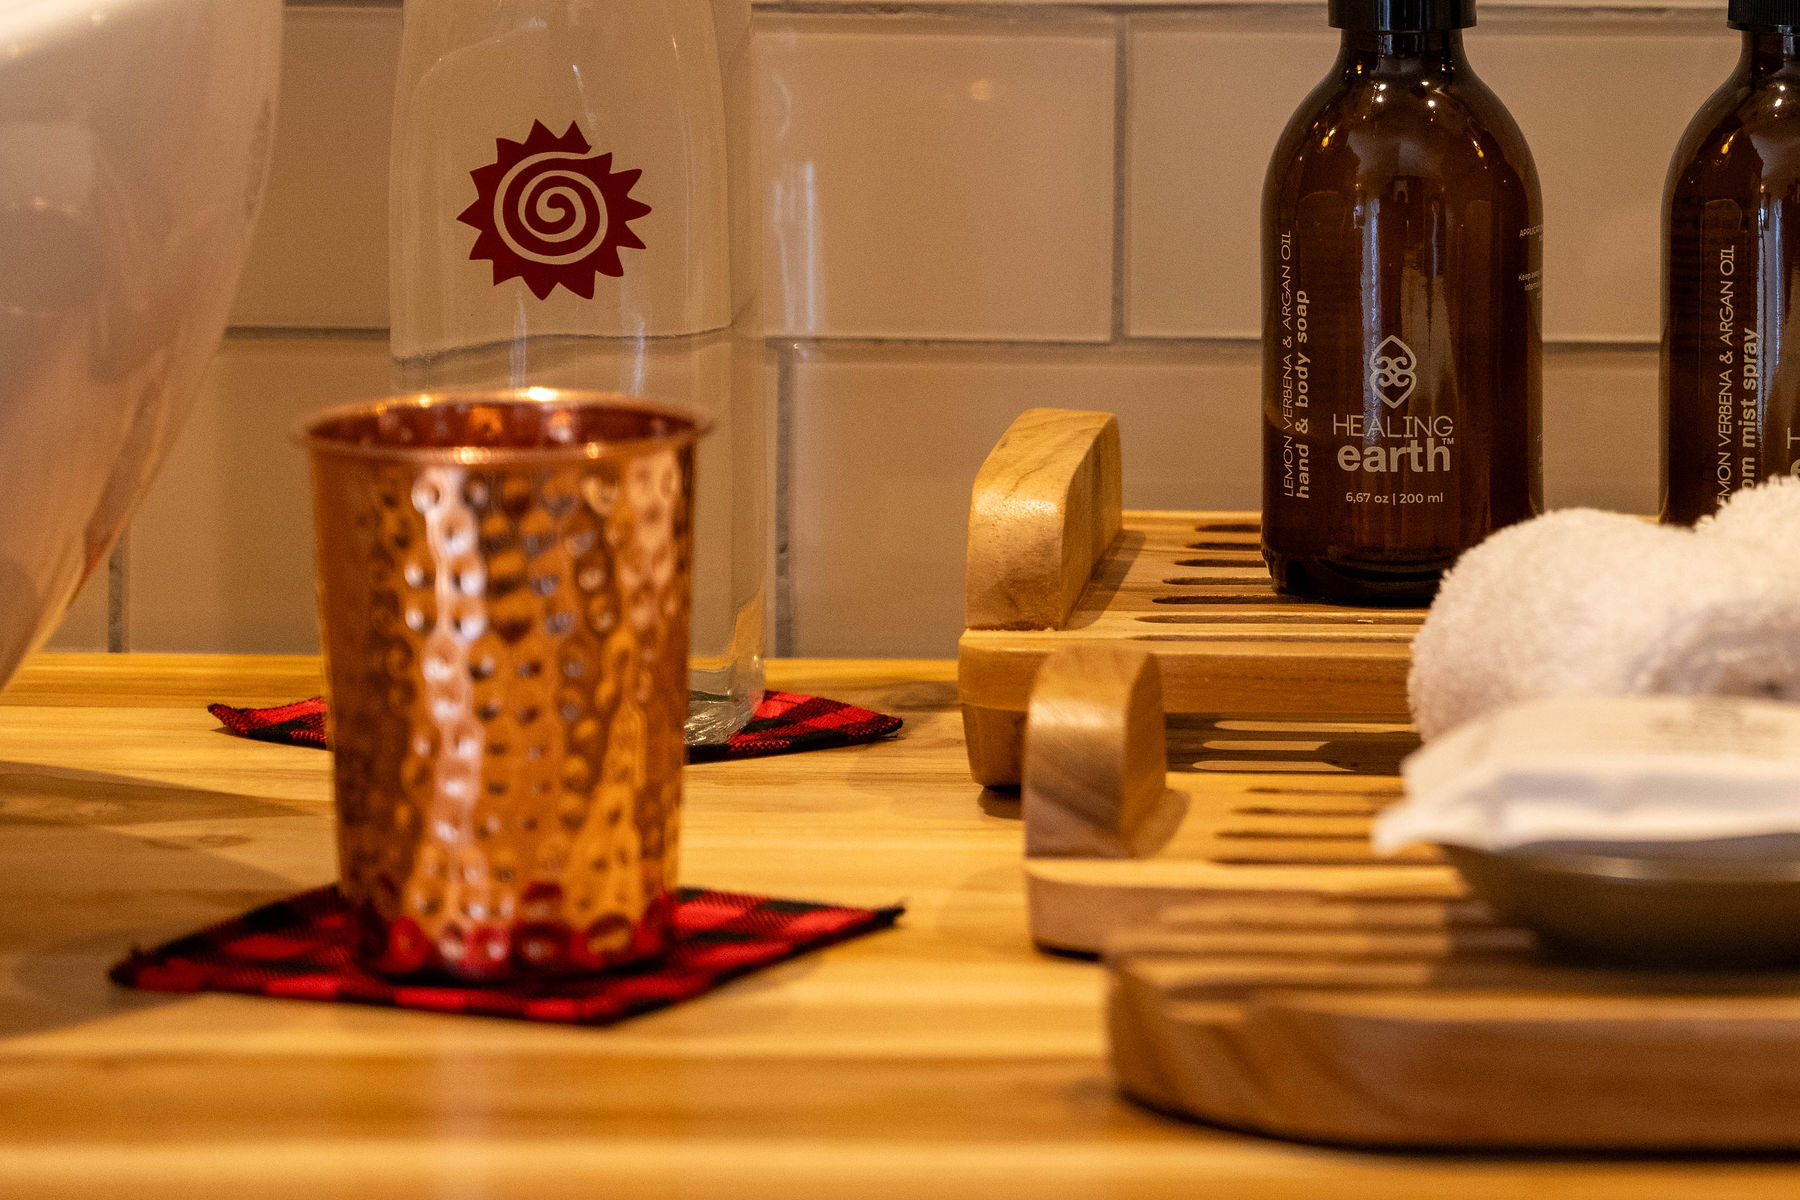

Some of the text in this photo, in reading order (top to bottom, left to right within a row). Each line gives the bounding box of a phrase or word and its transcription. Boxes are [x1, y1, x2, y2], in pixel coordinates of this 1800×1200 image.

[1281, 230, 1293, 497] LEMON VERBENA & ARGAN OIL
[1716, 245, 1735, 505] EMON VERBENA & ARGAN OIL
[1744, 328, 1762, 390] spray
[1295, 290, 1311, 499] hand & body soap
[1333, 414, 1454, 437] HEALING
[1738, 399, 1756, 449] mist
[1337, 438, 1450, 473] earth
[1345, 492, 1371, 504] 6,67
[1374, 494, 1389, 504] oz
[1399, 493, 1423, 504] 200
[1427, 492, 1443, 503] ml
